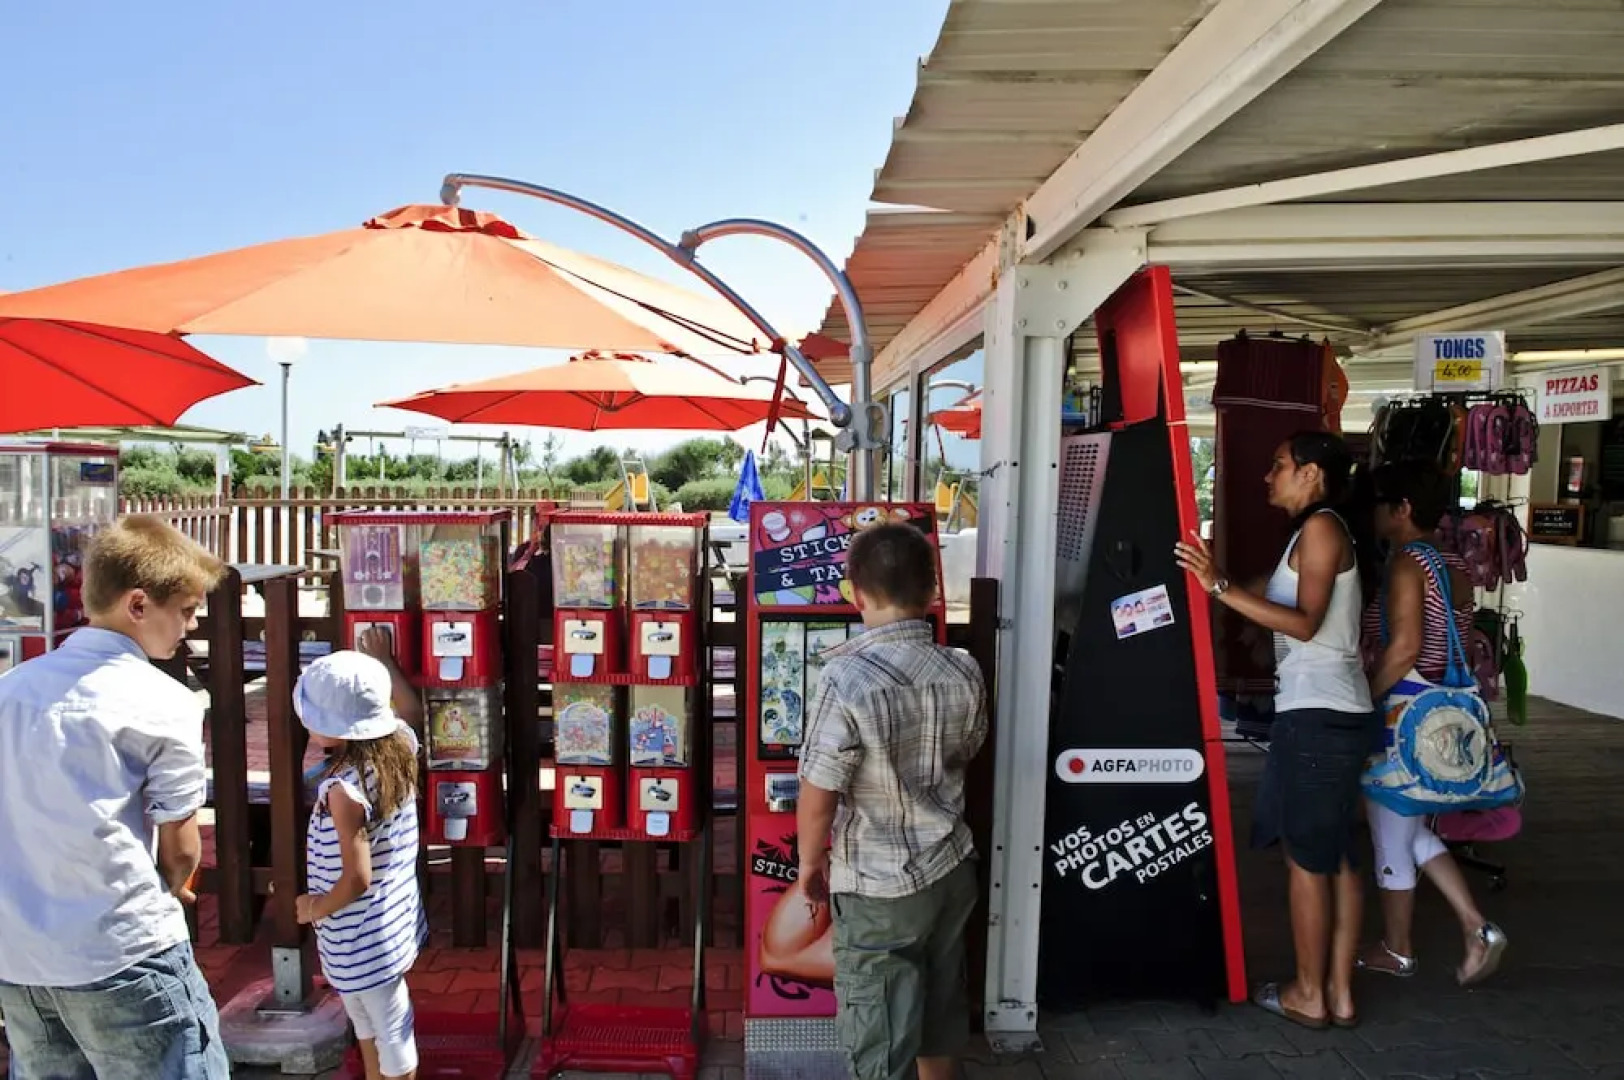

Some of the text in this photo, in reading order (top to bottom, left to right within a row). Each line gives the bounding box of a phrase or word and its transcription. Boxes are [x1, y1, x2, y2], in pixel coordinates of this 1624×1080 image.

[1433, 337, 1485, 359] TONGS
[1545, 374, 1599, 396] PIZZAS
[1552, 400, 1599, 417] EMPORTER
[781, 572, 796, 587] &
[1091, 759, 1193, 772] AGFAPHOTO
[1050, 825, 1092, 857] VOS
[1055, 811, 1156, 877] PHOTOS EN
[1081, 801, 1208, 890] CARTES
[1135, 829, 1214, 884] POSTALES
[754, 858, 799, 881] STIC
